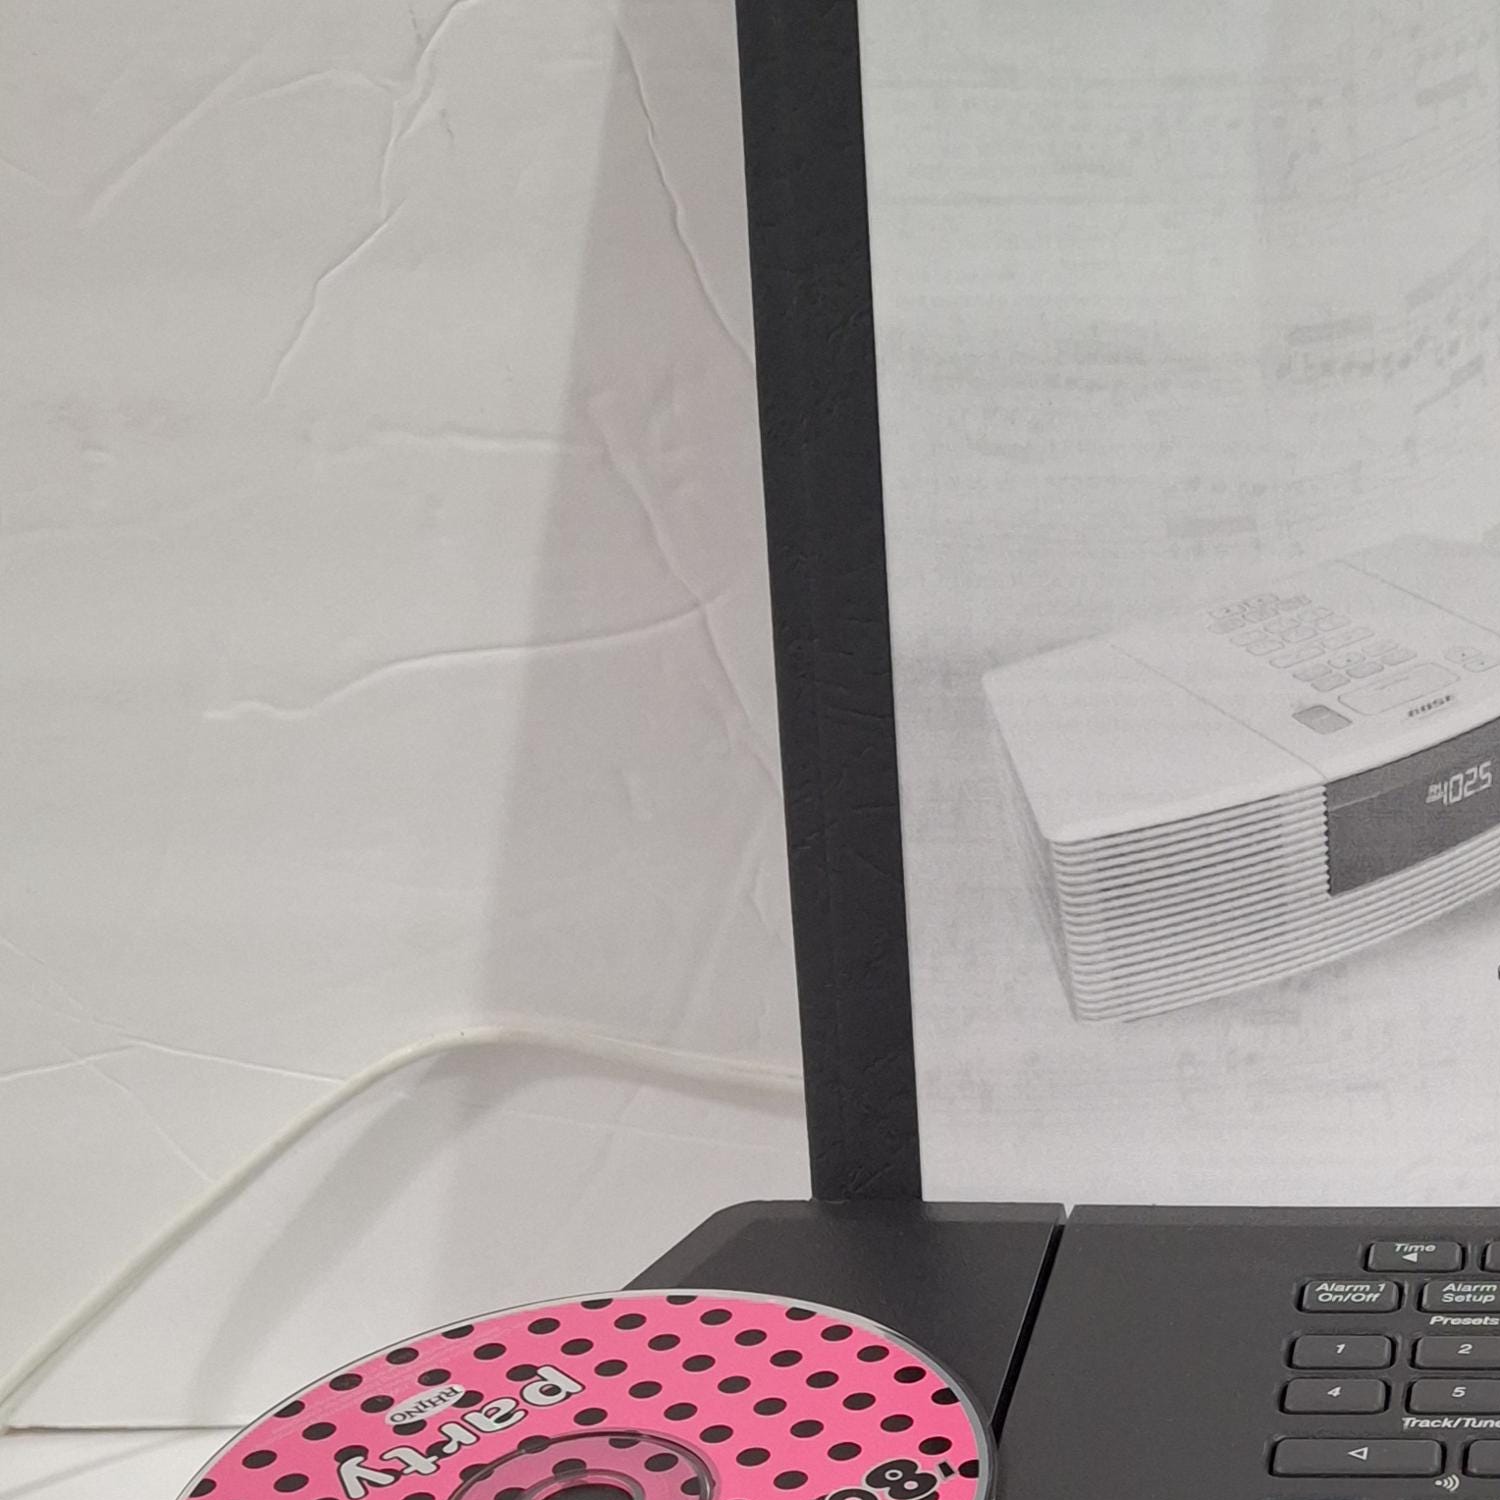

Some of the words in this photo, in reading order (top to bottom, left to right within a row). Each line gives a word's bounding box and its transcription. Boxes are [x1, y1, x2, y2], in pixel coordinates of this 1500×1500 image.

[1394, 1243, 1436, 1253] Time
[1315, 1282, 1374, 1293] Alarm
[1377, 1283, 1386, 1293] 1
[1442, 1282, 1497, 1293] Alarm
[1318, 1292, 1380, 1304] On/Off
[1442, 1292, 1496, 1304] Setup
[1429, 1315, 1500, 1327] Presets
[1336, 1344, 1346, 1354] 1
[1457, 1344, 1473, 1355] 2
[1327, 1386, 1341, 1398] 4
[1451, 1386, 1466, 1398] 5
[390, 1386, 461, 1423] RHINO
[335, 1364, 587, 1500] party
